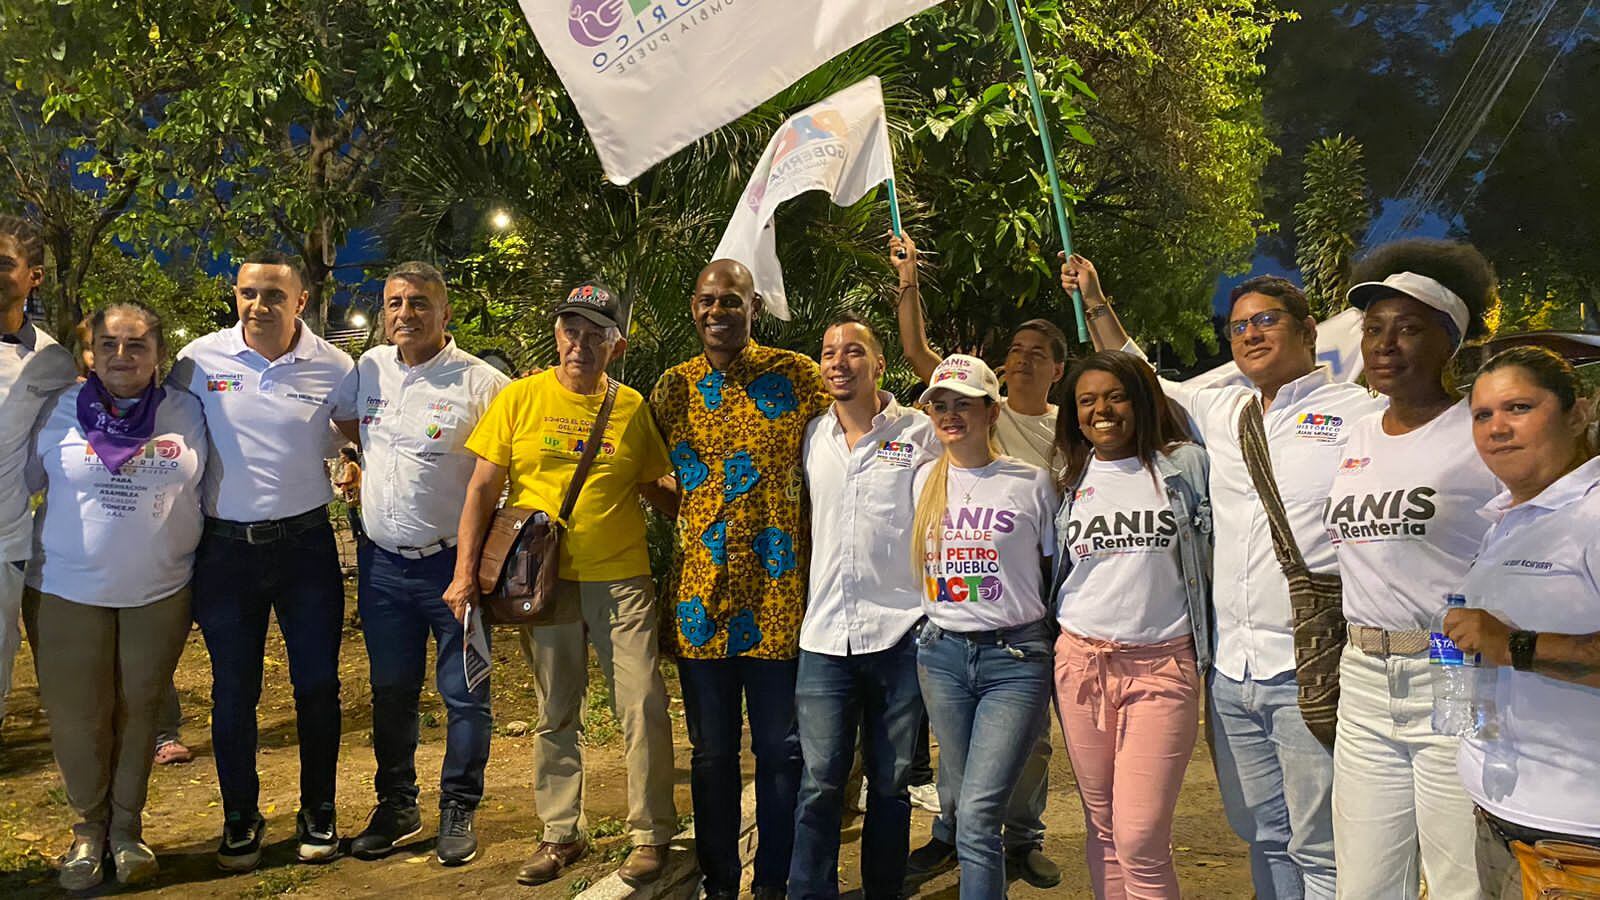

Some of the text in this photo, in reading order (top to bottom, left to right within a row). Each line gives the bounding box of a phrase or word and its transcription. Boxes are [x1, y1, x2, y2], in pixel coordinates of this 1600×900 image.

[934, 371, 968, 384] PACTO
[1297, 413, 1343, 427] PACTO
[880, 442, 913, 453] PACTO
[99, 490, 139, 498] ASAMBLEA
[102, 503, 136, 511] CONCEJO
[936, 507, 1016, 533] ANIS
[1340, 518, 1426, 539] Rentería
[1092, 533, 1170, 550] Rentería
[946, 547, 998, 561] PETRO
[946, 561, 999, 574] PUEBLO
[925, 575, 1003, 603] PACTO
